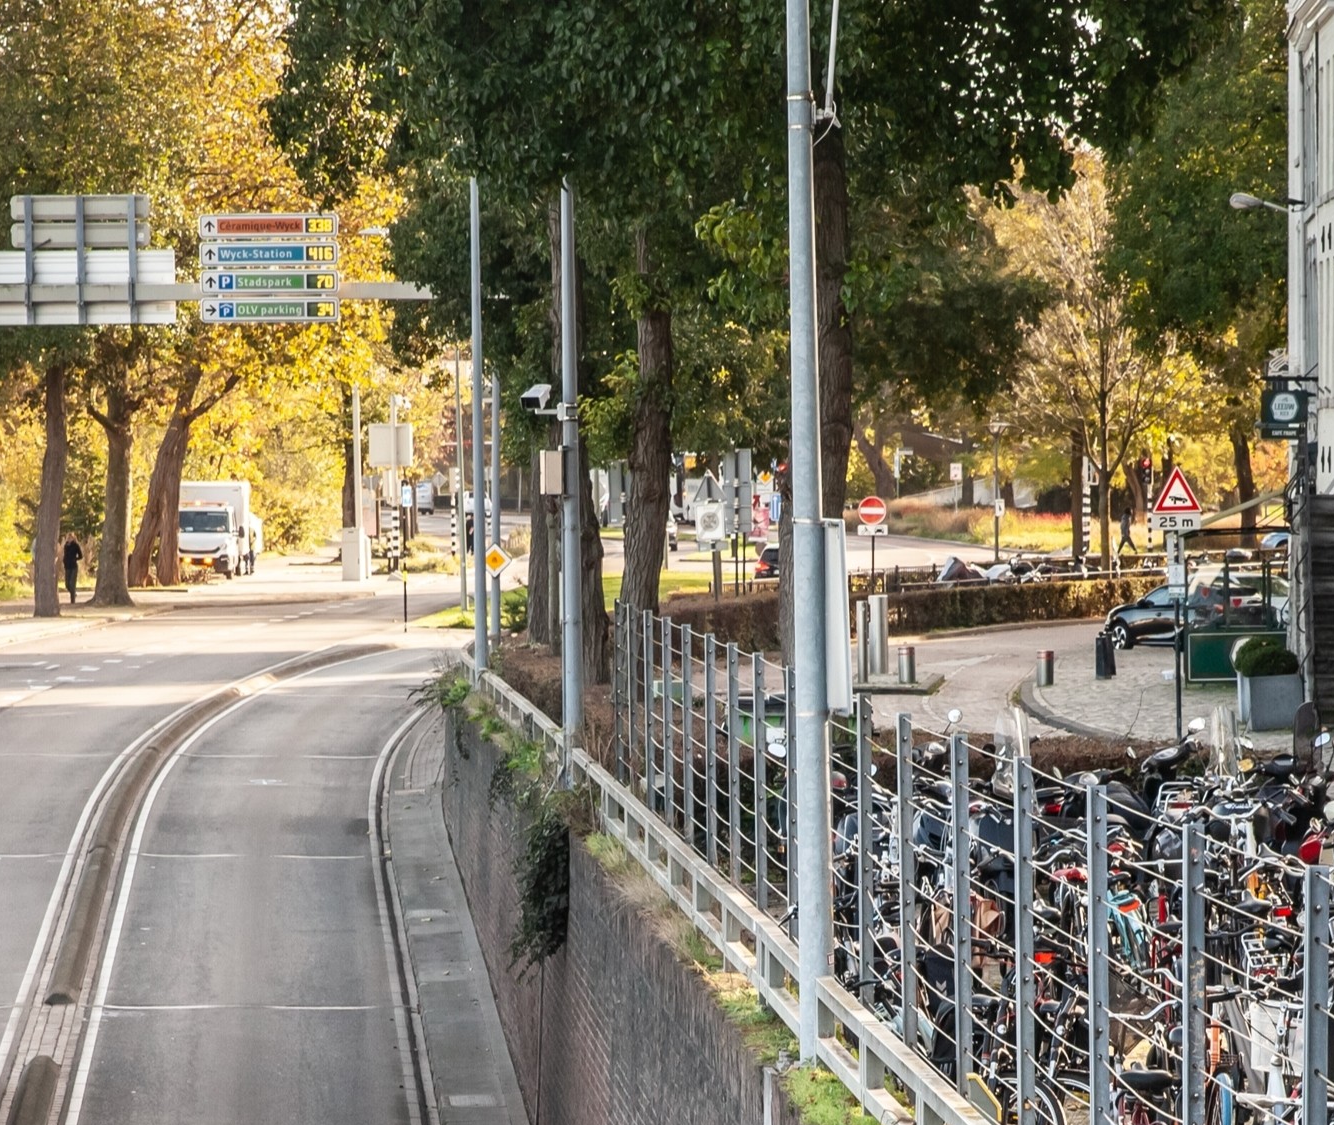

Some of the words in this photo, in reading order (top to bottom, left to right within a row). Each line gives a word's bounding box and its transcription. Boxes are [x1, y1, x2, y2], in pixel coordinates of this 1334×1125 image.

[308, 218, 334, 232] 338
[220, 248, 293, 261] Wyck-Station
[308, 247, 334, 261] 416
[221, 276, 231, 287] P
[238, 276, 292, 290] Stadspark
[317, 275, 334, 288] 70
[238, 305, 258, 314] OLV
[261, 304, 302, 317] parking
[317, 303, 334, 317] 34
[1159, 517, 1177, 528] 25
[1182, 519, 1193, 527] m
